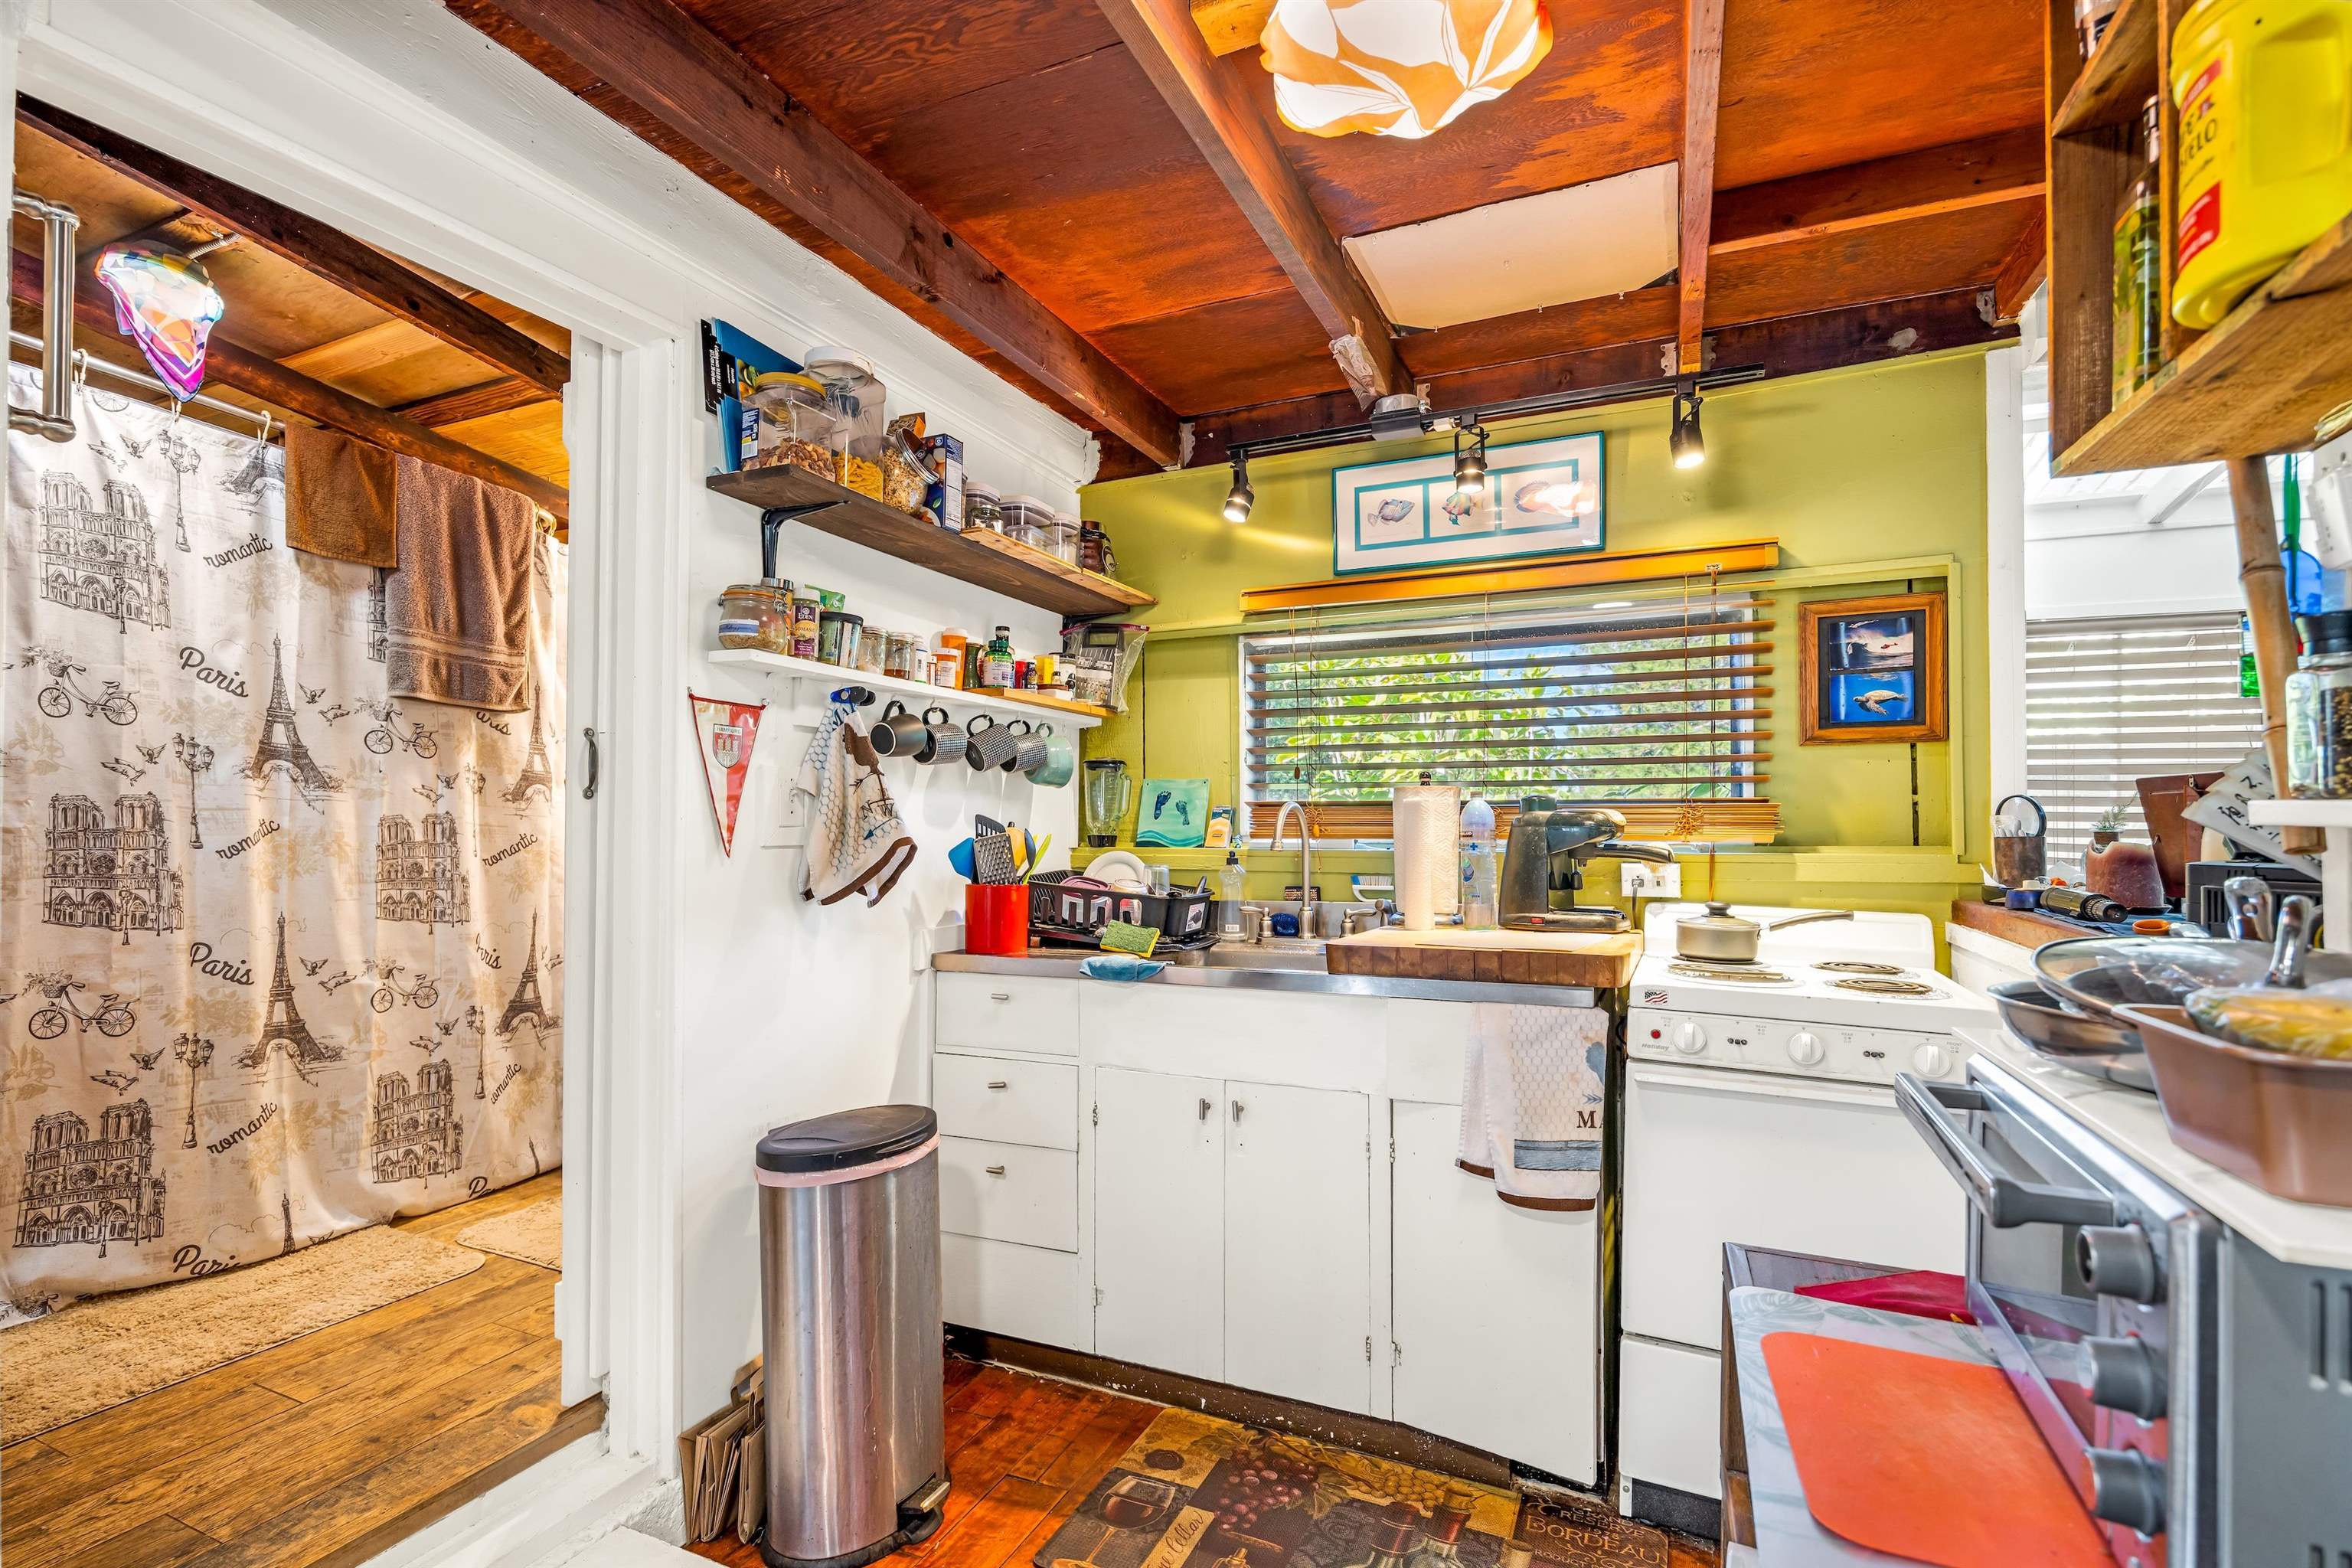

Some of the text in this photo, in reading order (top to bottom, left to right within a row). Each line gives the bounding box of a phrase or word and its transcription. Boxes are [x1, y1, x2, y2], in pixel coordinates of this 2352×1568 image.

[203, 533, 273, 568] romantic
[179, 646, 249, 697] Paris
[476, 710, 511, 735] aris
[215, 818, 280, 859] romantic
[482, 833, 538, 867] romantic
[190, 942, 254, 985] Paris
[1642, 1043, 1669, 1051] Holiday
[207, 1102, 277, 1154] romantic
[1576, 1110, 1603, 1129] M
[173, 1244, 240, 1276] Pari
[1560, 1510, 1645, 1538] RESERVE
[1534, 1548, 1587, 1567] RODUCT
